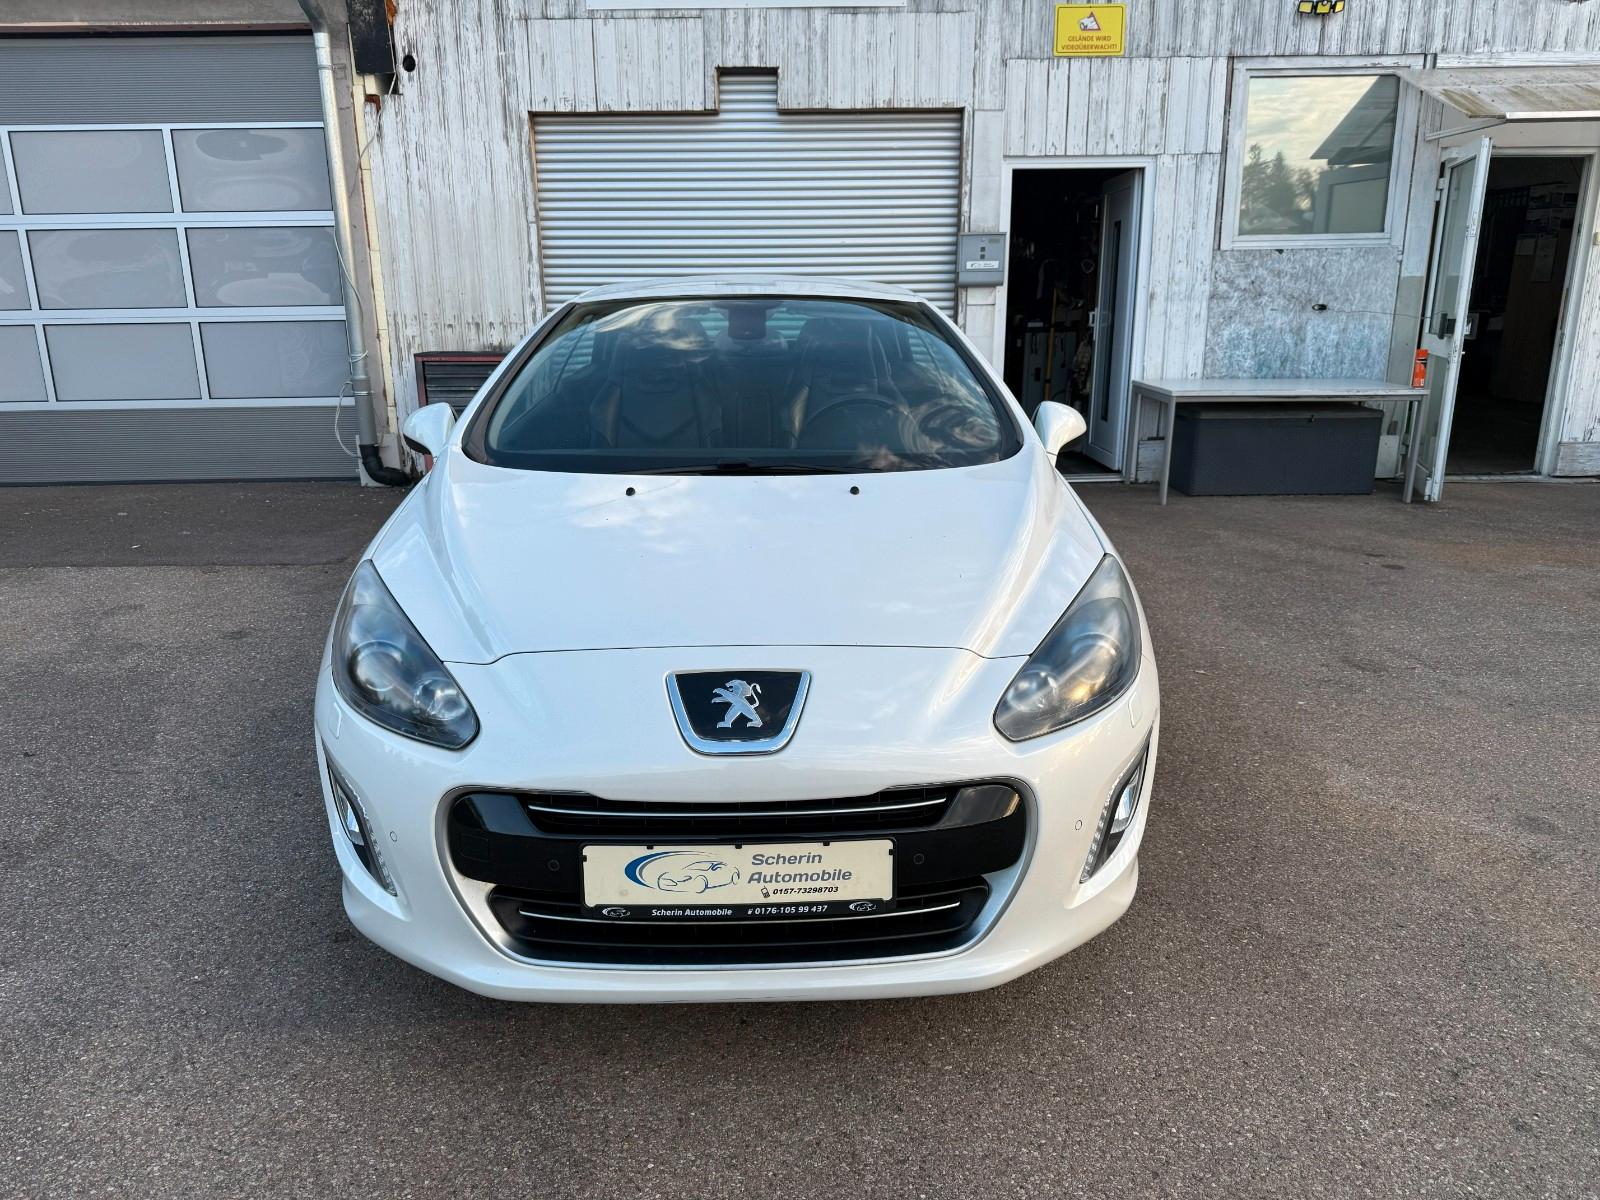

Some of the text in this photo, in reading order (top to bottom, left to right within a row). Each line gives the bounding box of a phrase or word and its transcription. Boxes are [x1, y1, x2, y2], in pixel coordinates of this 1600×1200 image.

[1067, 34, 1095, 42] GELÄNDE
[751, 852, 823, 866] Scherin
[747, 868, 852, 884] Automobile
[772, 886, 839, 895] 0157-73298703
[651, 908, 733, 916] Scherin Automobile
[754, 904, 828, 915] 0176-105 99 437
